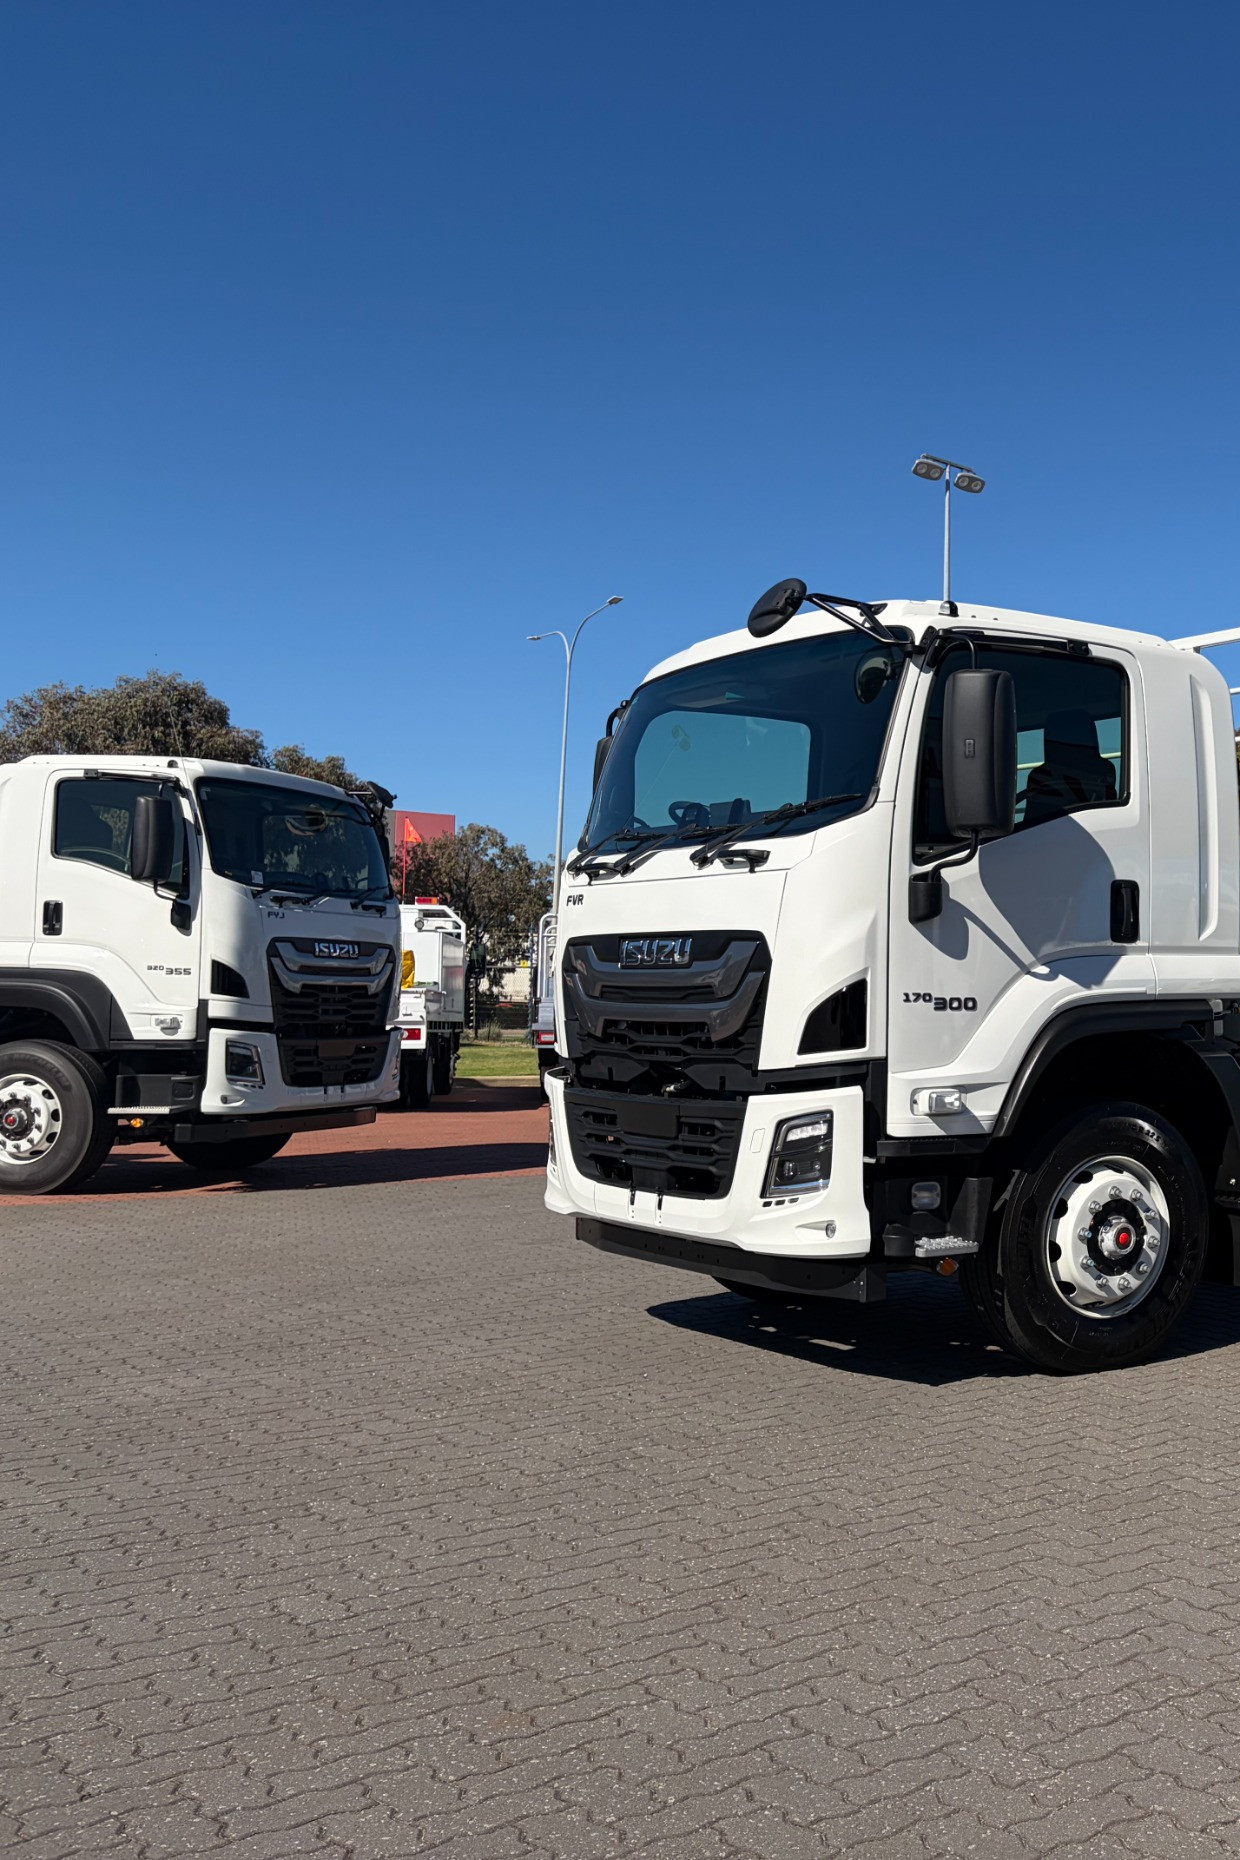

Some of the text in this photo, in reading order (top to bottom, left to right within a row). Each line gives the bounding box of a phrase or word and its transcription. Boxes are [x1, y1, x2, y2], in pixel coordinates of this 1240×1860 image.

[566, 894, 584, 906] FVR
[267, 911, 285, 919] FYJ
[314, 942, 359, 958] ISUZU
[621, 939, 693, 966] ISUZU
[165, 967, 192, 976] 355
[902, 992, 978, 1012] 170 300
